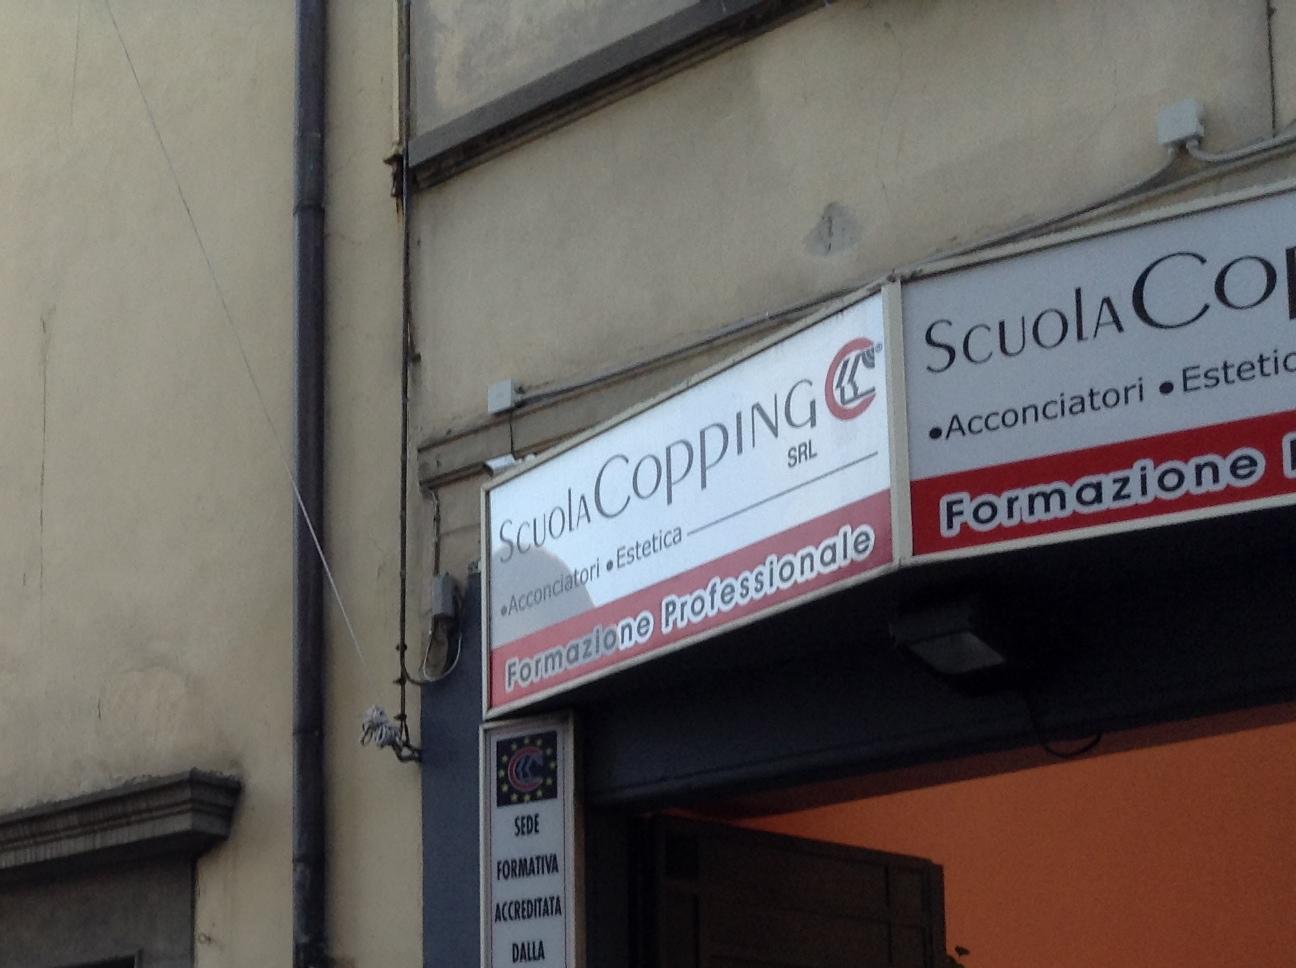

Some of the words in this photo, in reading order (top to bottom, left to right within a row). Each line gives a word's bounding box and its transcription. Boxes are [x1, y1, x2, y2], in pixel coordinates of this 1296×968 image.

[945, 377, 1145, 441] Acconciatori
[787, 440, 818, 469] SRL
[943, 449, 1261, 535] Formazione
[508, 557, 601, 616] Acconciatori
[616, 526, 683, 570] Estetica
[506, 612, 653, 689] Formazione
[663, 526, 874, 630] Professionale
[514, 813, 540, 838] SEDE
[496, 853, 559, 881] FORMATIVA
[494, 895, 562, 924] ACCREDITATA
[512, 940, 545, 964] DALLA
